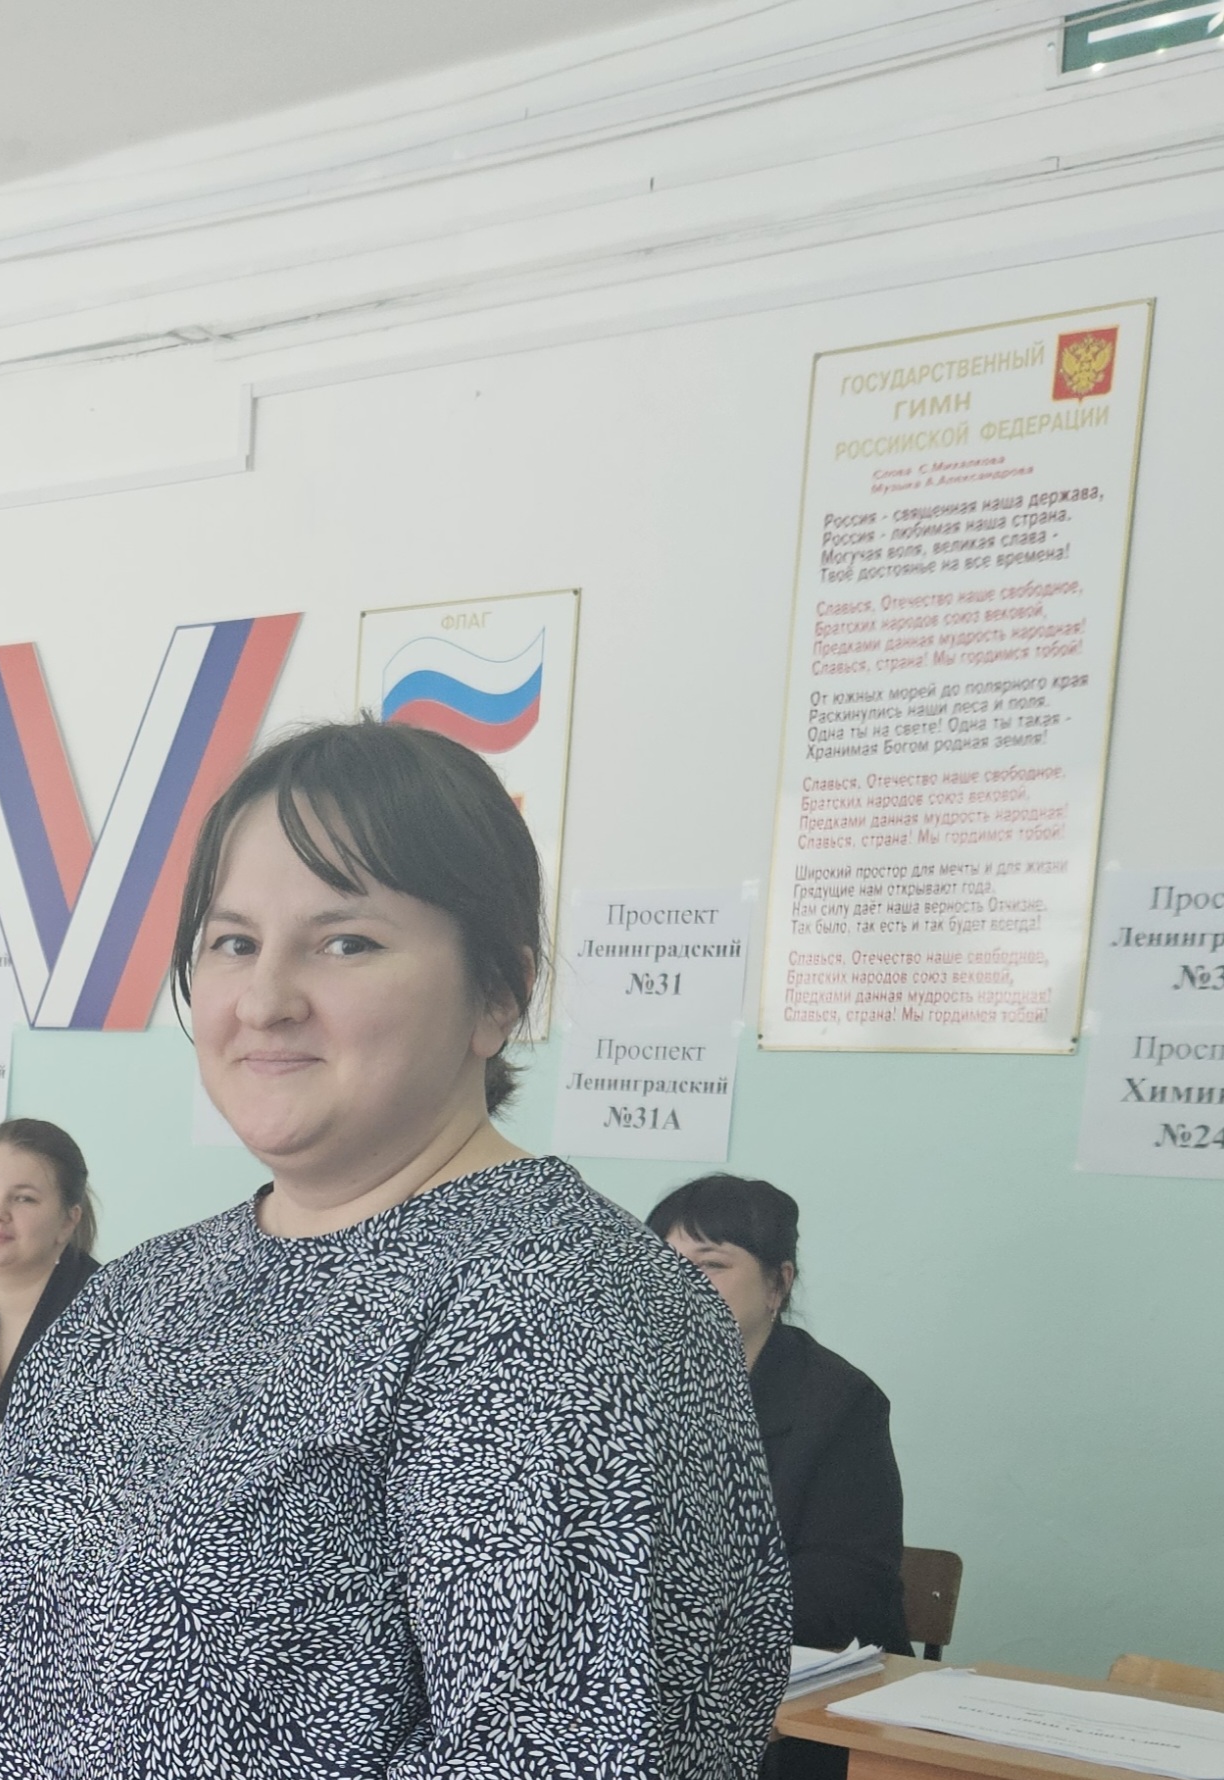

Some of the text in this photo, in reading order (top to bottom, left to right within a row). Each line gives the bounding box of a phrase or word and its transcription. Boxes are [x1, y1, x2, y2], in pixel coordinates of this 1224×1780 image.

[840, 341, 1046, 397] ГОСУДАРСТВЕННЫЙ
[892, 390, 973, 421] ГИМН
[979, 404, 1110, 443] ФЕДЕРАЦИИ
[823, 512, 877, 529] Россия
[892, 500, 977, 523] священная
[981, 495, 1024, 512] наша
[822, 530, 875, 547] Россия
[890, 520, 961, 540] любимая
[965, 516, 1007, 532] наша
[820, 547, 883, 566] Могучая
[932, 536, 996, 555] великая
[1000, 530, 1047, 548] слава
[820, 565, 854, 583] Твоё
[857, 560, 937, 582] достоянье
[941, 558, 960, 572] на
[964, 555, 992, 570] все
[440, 612, 492, 631] ФЛАГ
[810, 674, 1089, 707] От южных морей до полярного края
[808, 706, 903, 725] Раскинулись
[907, 703, 948, 718] наши
[951, 700, 989, 715] леса
[993, 699, 1004, 711] и
[807, 726, 845, 743] Одна
[850, 726, 868, 739] ты
[872, 725, 890, 738] на
[947, 716, 987, 734] Одна
[993, 716, 1013, 730] ты
[1018, 713, 1060, 728] такая
[805, 743, 879, 762] Хранимая
[883, 738, 930, 755] Богом
[933, 736, 989, 754] родная
[866, 771, 980, 789] Отечество наше
[801, 791, 964, 813] Братских народов союз
[799, 815, 866, 833] Предками
[870, 813, 919, 829] данная
[923, 811, 991, 828] мудрость
[917, 828, 940, 845] Мы
[944, 828, 1013, 845] гордимся
[795, 860, 1068, 883] Широкий простор для мечты и для жизни
[793, 883, 855, 902] Грядущие
[859, 884, 883, 897] нам
[886, 882, 957, 897] открывают
[1149, 885, 1224, 918] Прос
[606, 903, 719, 931] Проспект
[791, 900, 817, 917] Нам
[820, 903, 850, 919] силу
[852, 900, 883, 917] даёт
[886, 902, 920, 915] наша
[923, 901, 984, 916] верность
[791, 919, 811, 935] Так
[856, 921, 875, 933] так
[879, 920, 908, 933] есть
[911, 920, 920, 932] и
[924, 920, 944, 932] так
[948, 915, 987, 935] будет
[577, 938, 742, 963] Ленинградский
[851, 949, 922, 966] Отечество
[925, 952, 963, 965] наше
[625, 972, 683, 996] №31
[786, 969, 847, 987] Братских
[851, 971, 908, 985] народов
[912, 971, 948, 984] союз
[784, 987, 852, 1006] Предками
[854, 991, 903, 1004] данная
[907, 991, 974, 1006] мудрость
[901, 1006, 924, 1022] Мы
[928, 1009, 997, 1025] гордимся
[595, 1038, 707, 1065] Проспект
[566, 1072, 729, 1097] Ленинградский
[603, 1105, 683, 1131] №31А
